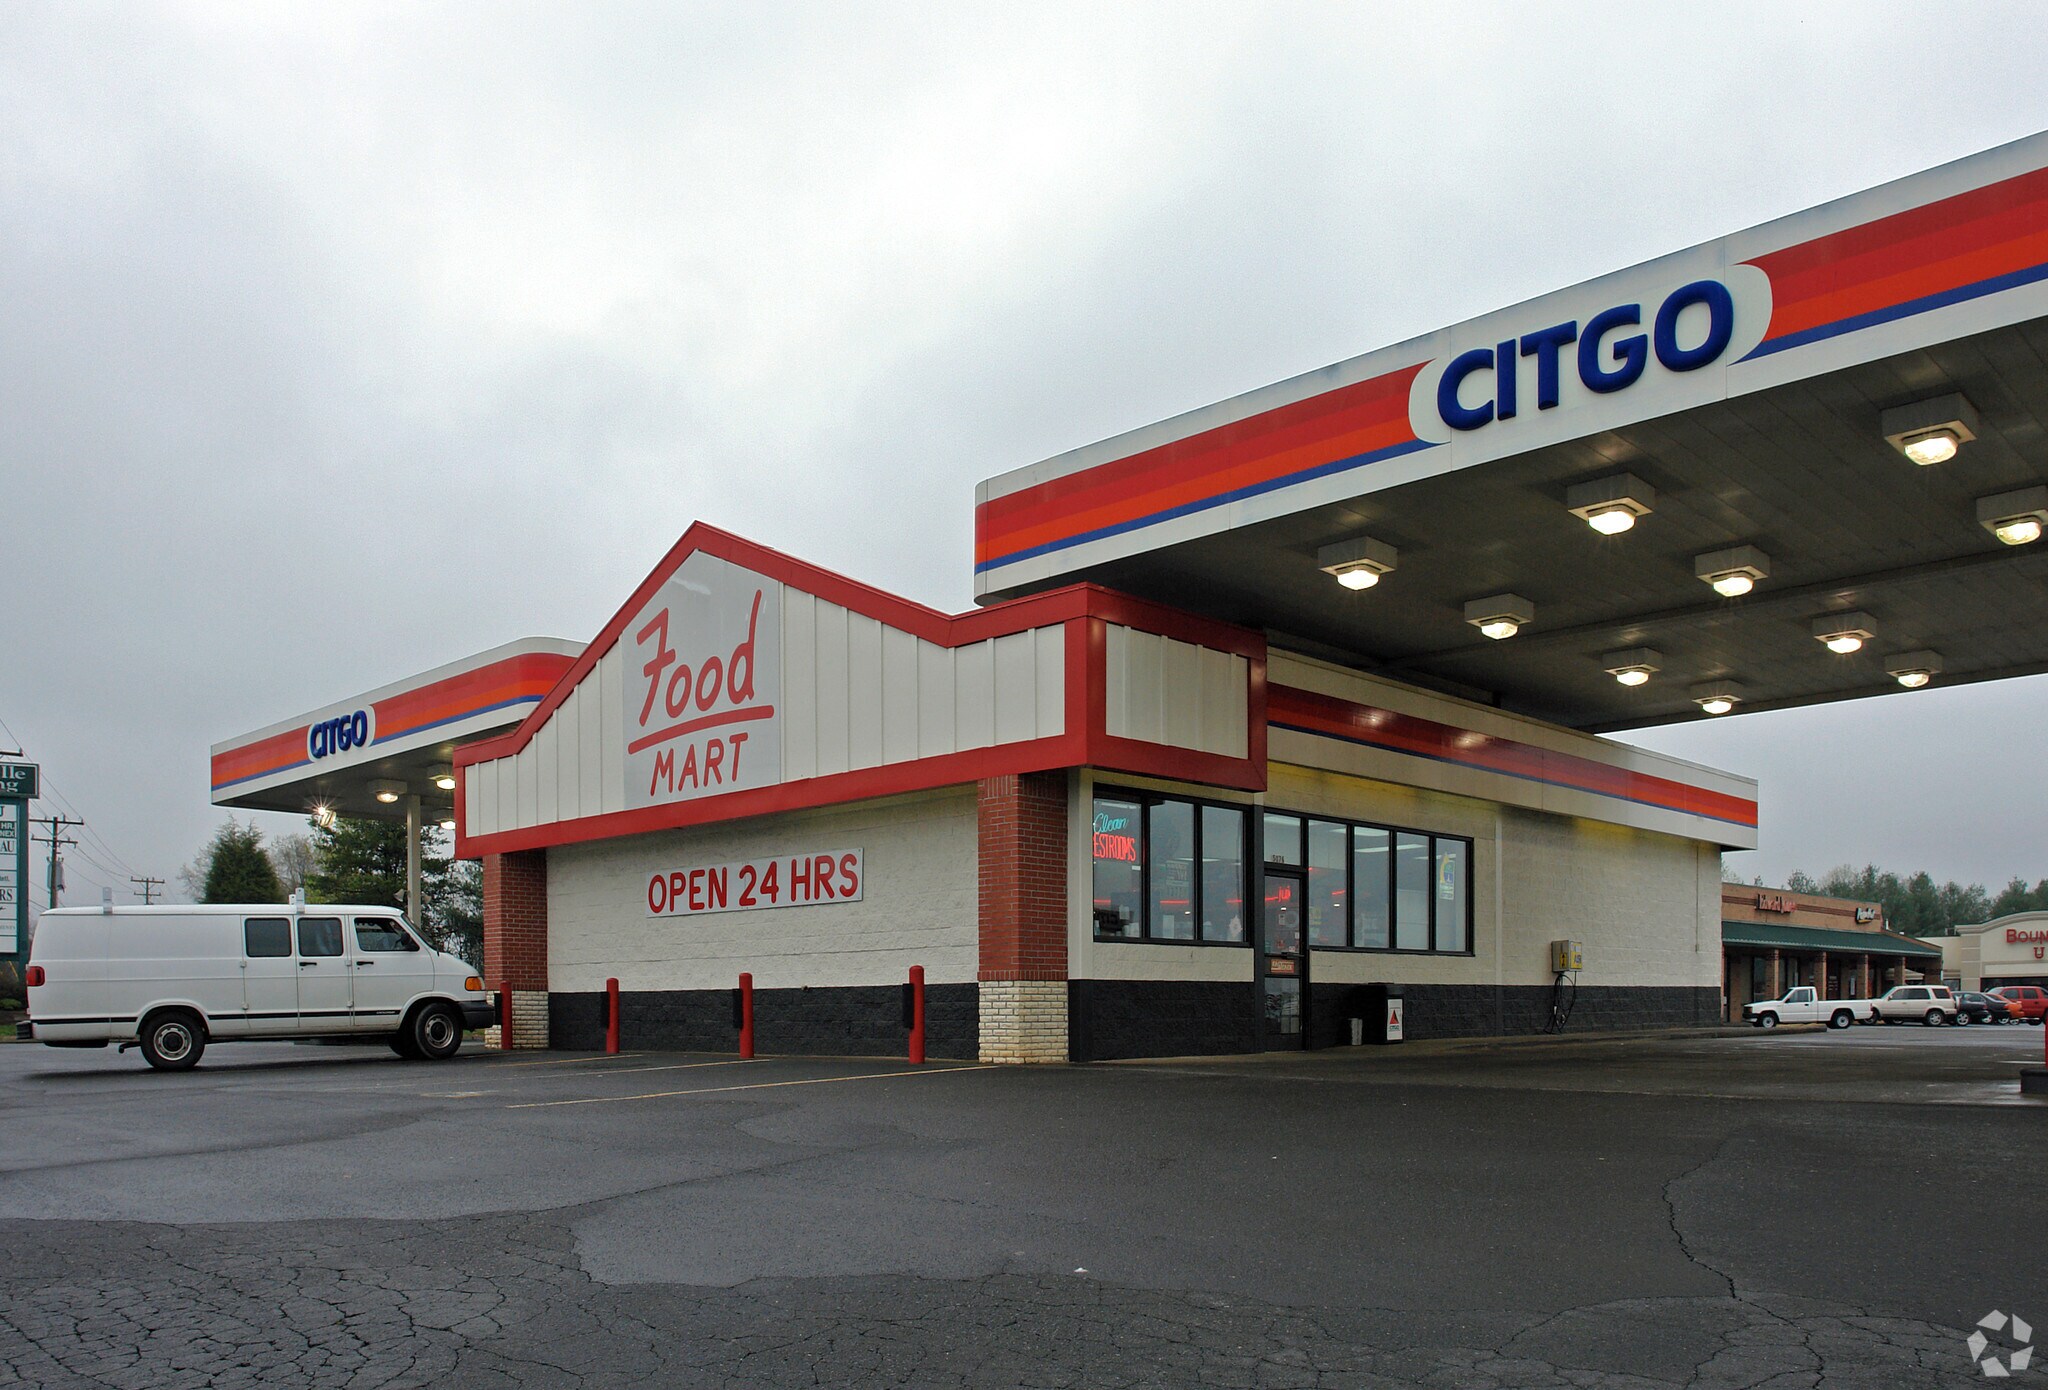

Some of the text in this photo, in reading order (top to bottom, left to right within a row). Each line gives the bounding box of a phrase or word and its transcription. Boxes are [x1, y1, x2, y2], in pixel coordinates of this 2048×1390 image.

[1437, 280, 1734, 431] CITGO
[636, 589, 762, 727] Food
[310, 709, 368, 759] CITGO
[650, 732, 749, 796] MART
[1093, 813, 1129, 833] Clean
[1093, 832, 1137, 862] ESTROOMS
[648, 853, 859, 914] OPEN 24 HRS
